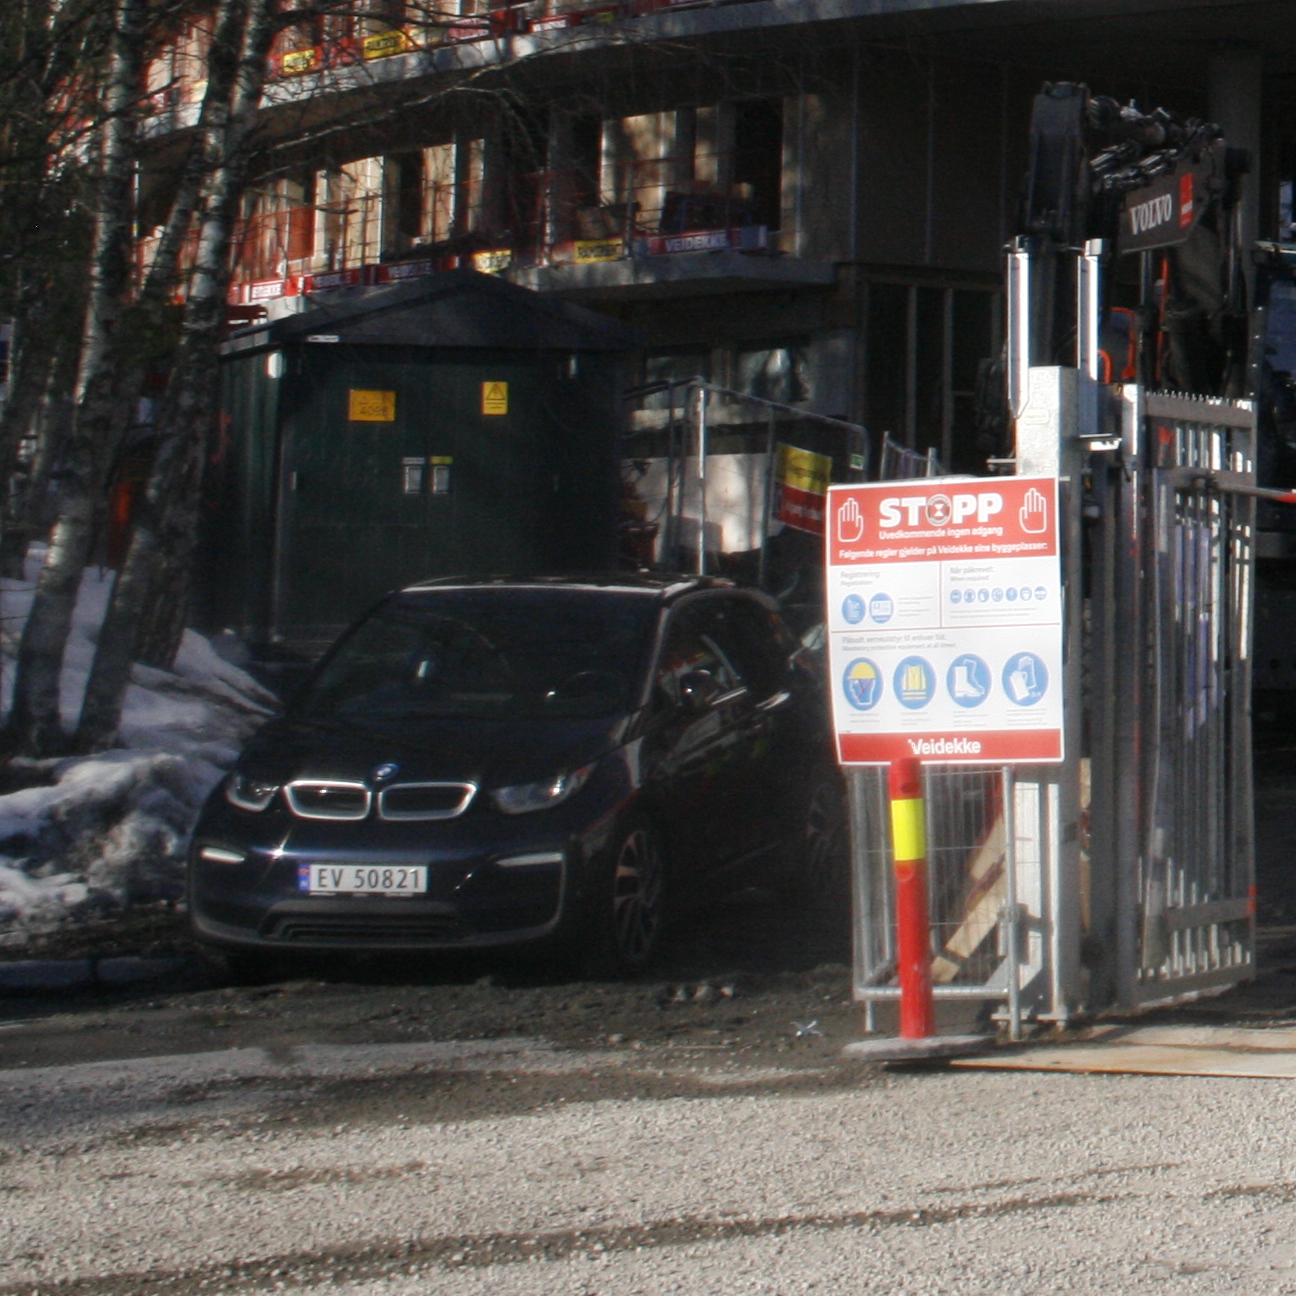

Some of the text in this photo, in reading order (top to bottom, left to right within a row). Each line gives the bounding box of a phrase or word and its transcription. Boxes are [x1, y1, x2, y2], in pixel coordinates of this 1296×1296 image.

[1129, 193, 1172, 236] VOLVO
[878, 492, 1004, 528] STOPP
[878, 526, 1004, 540] Uvedkommende ingen adgang
[839, 548, 875, 561] Følgende
[875, 548, 898, 559] regler
[898, 547, 926, 559] gjelder
[926, 546, 938, 556] på
[938, 544, 974, 554] Veidekke
[974, 543, 991, 552] sine
[910, 737, 982, 756] Veidekke
[318, 868, 420, 889] EV 50821
